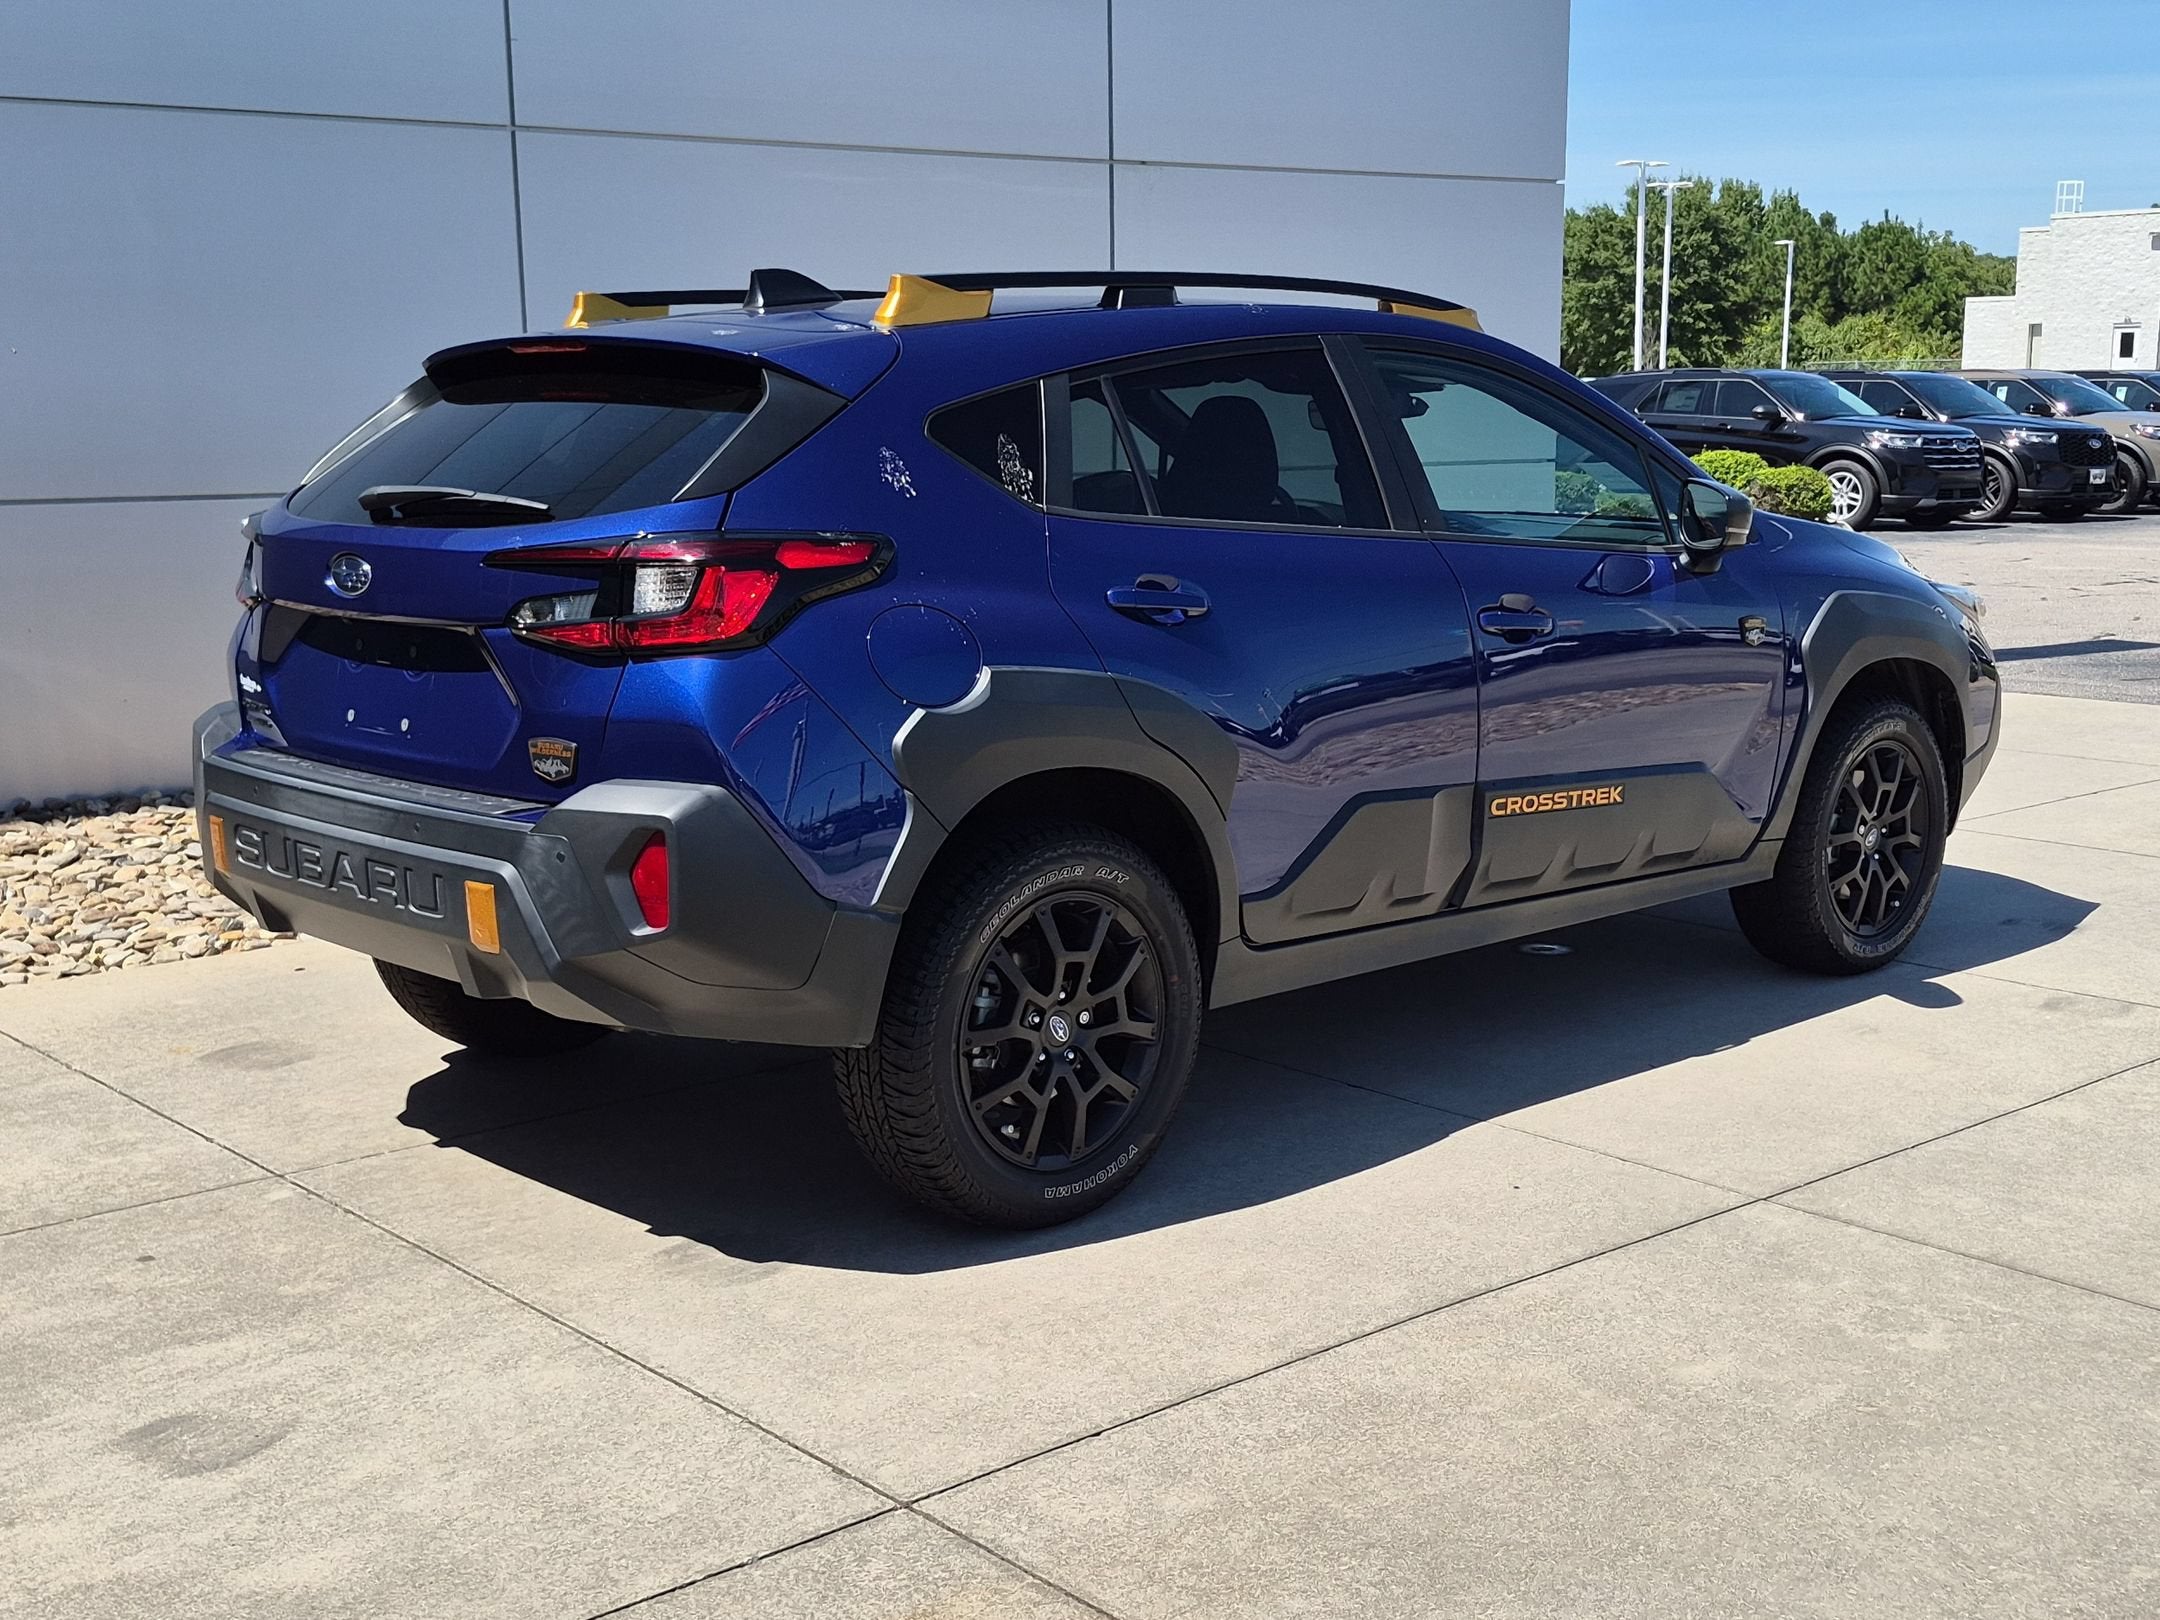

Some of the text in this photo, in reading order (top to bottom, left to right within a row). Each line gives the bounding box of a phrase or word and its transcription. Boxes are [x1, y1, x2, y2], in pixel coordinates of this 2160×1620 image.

[1490, 785, 1624, 816] CROSSTREK
[234, 823, 445, 919] SUBARU
[980, 865, 1129, 943] GEOLANDAR A/T
[1044, 1144, 1139, 1198] YOKOHAMA
